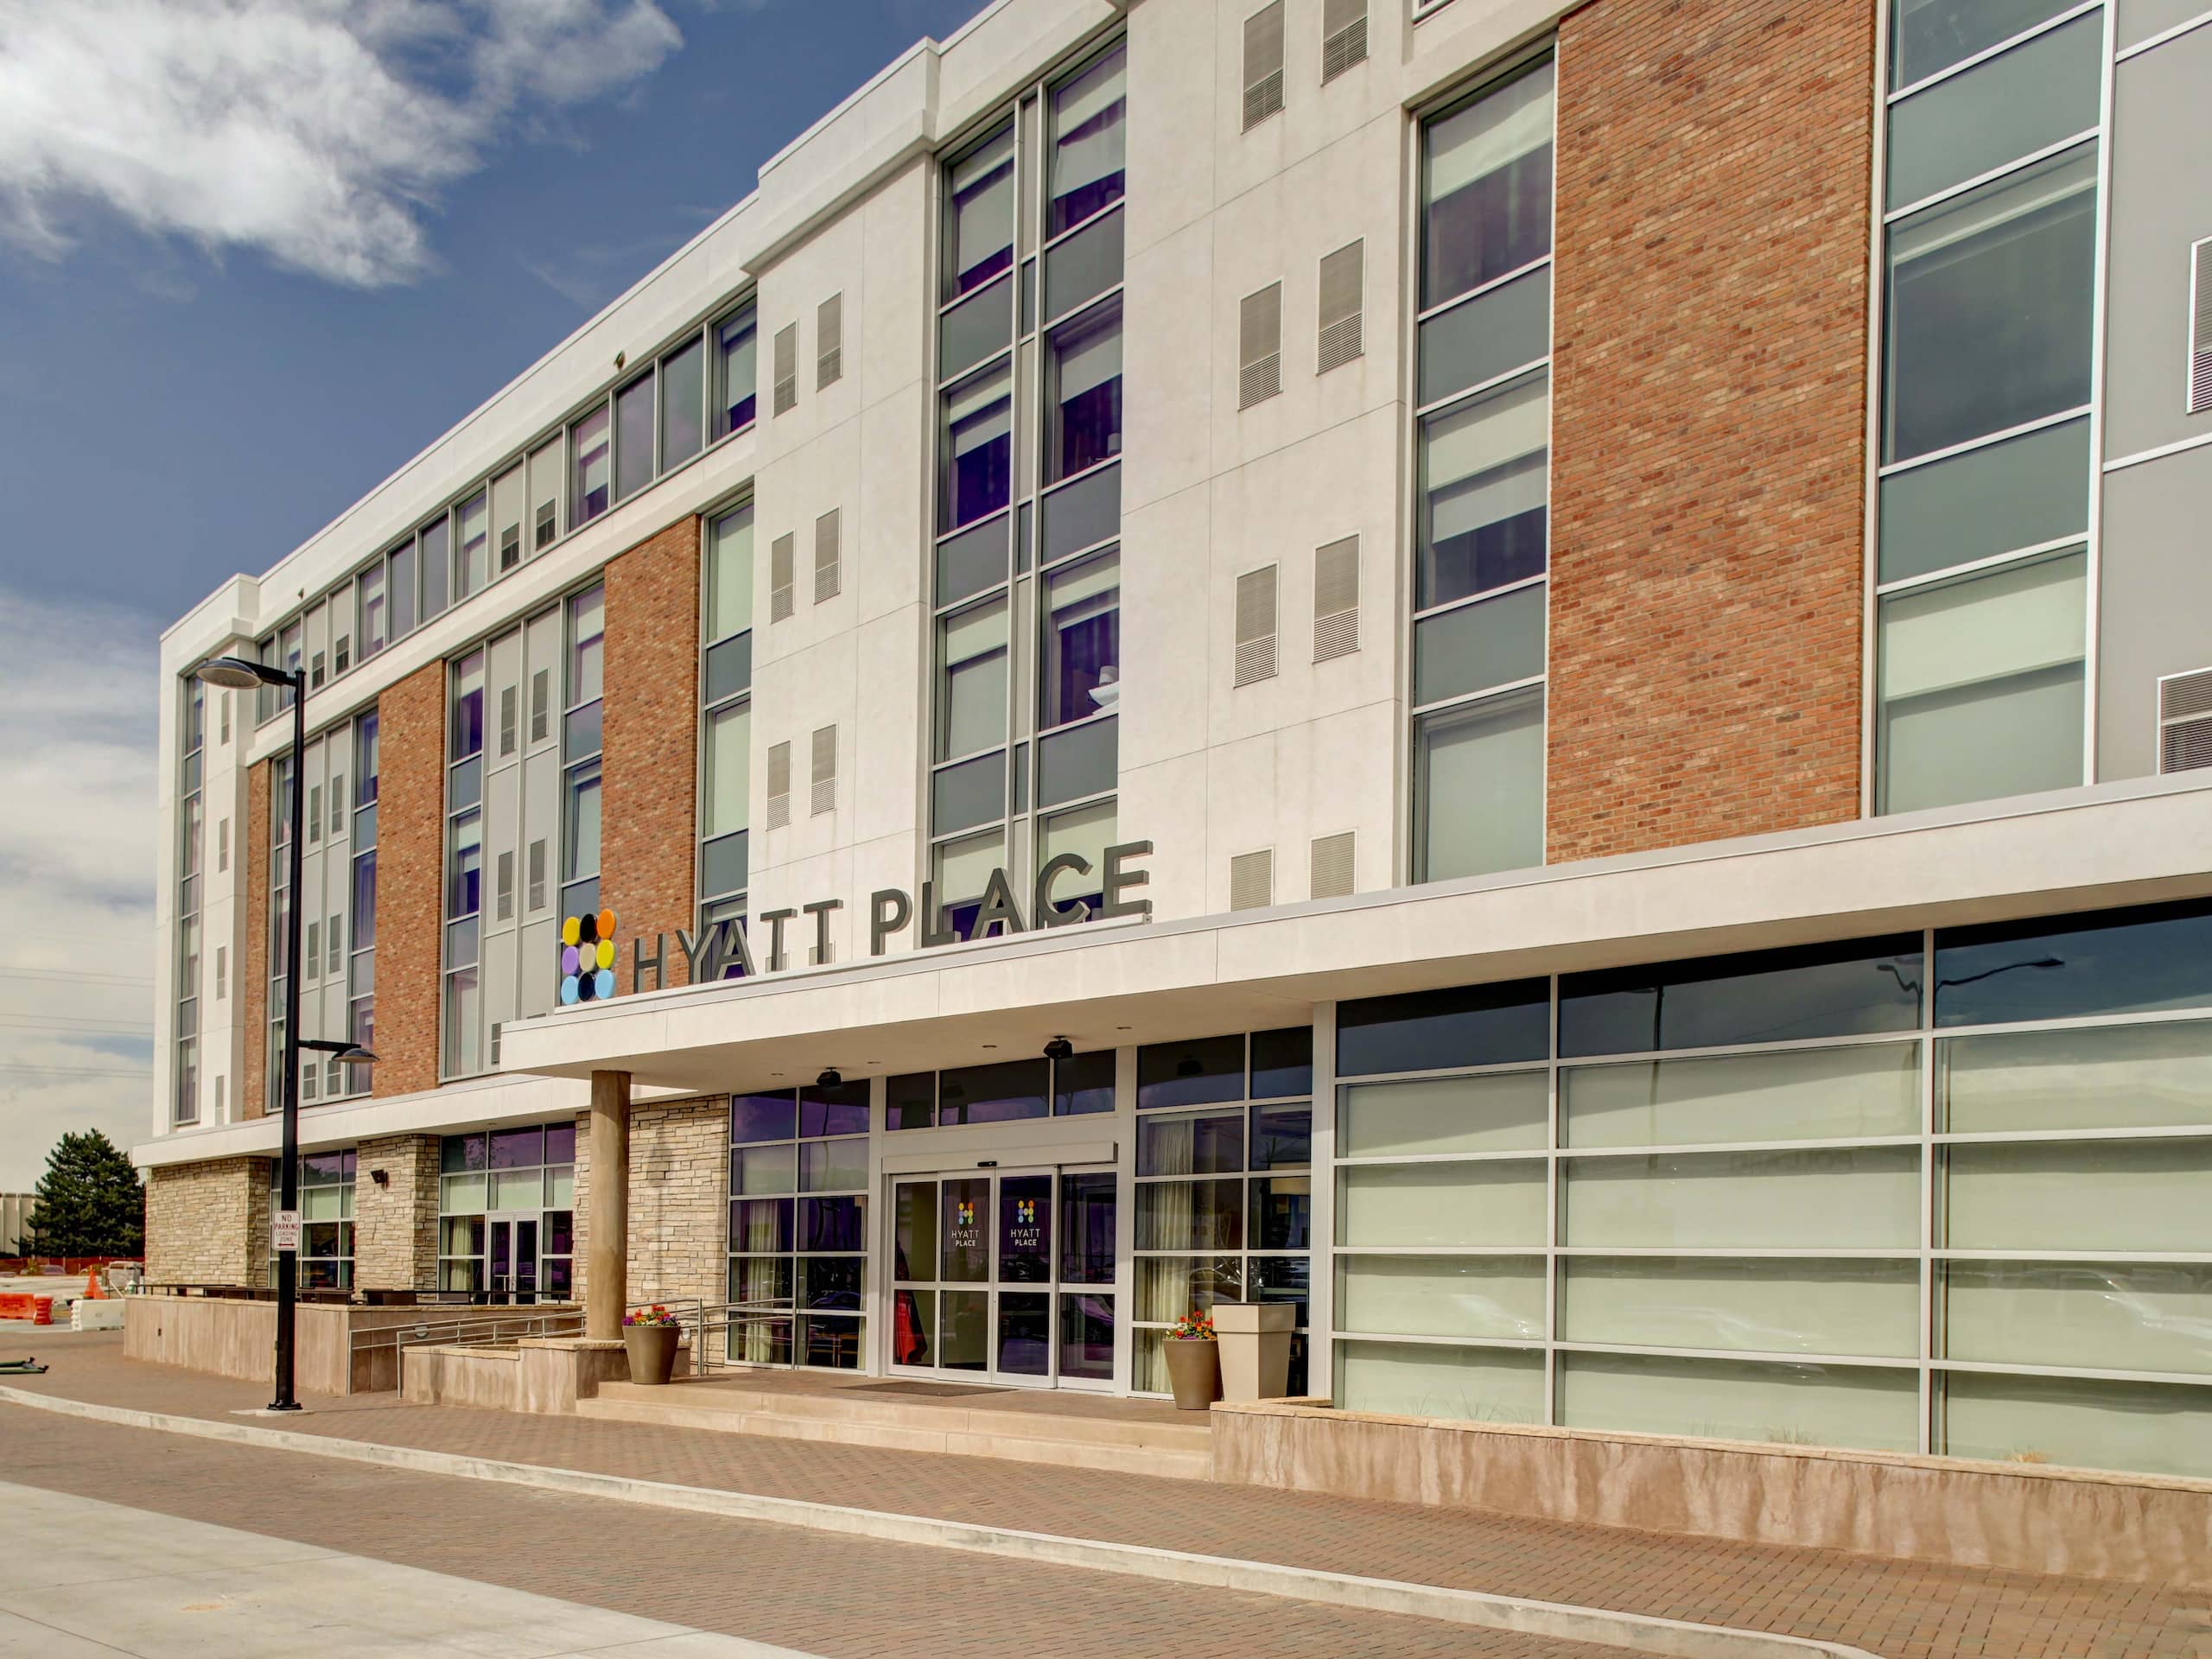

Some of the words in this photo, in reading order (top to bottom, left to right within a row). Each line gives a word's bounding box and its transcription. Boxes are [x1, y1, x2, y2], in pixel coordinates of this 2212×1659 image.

[633, 899, 843, 994] HYATT
[871, 840, 1154, 955] PLACE
[951, 1230, 979, 1238] HYATT
[1010, 1229, 1040, 1237] HYATT
